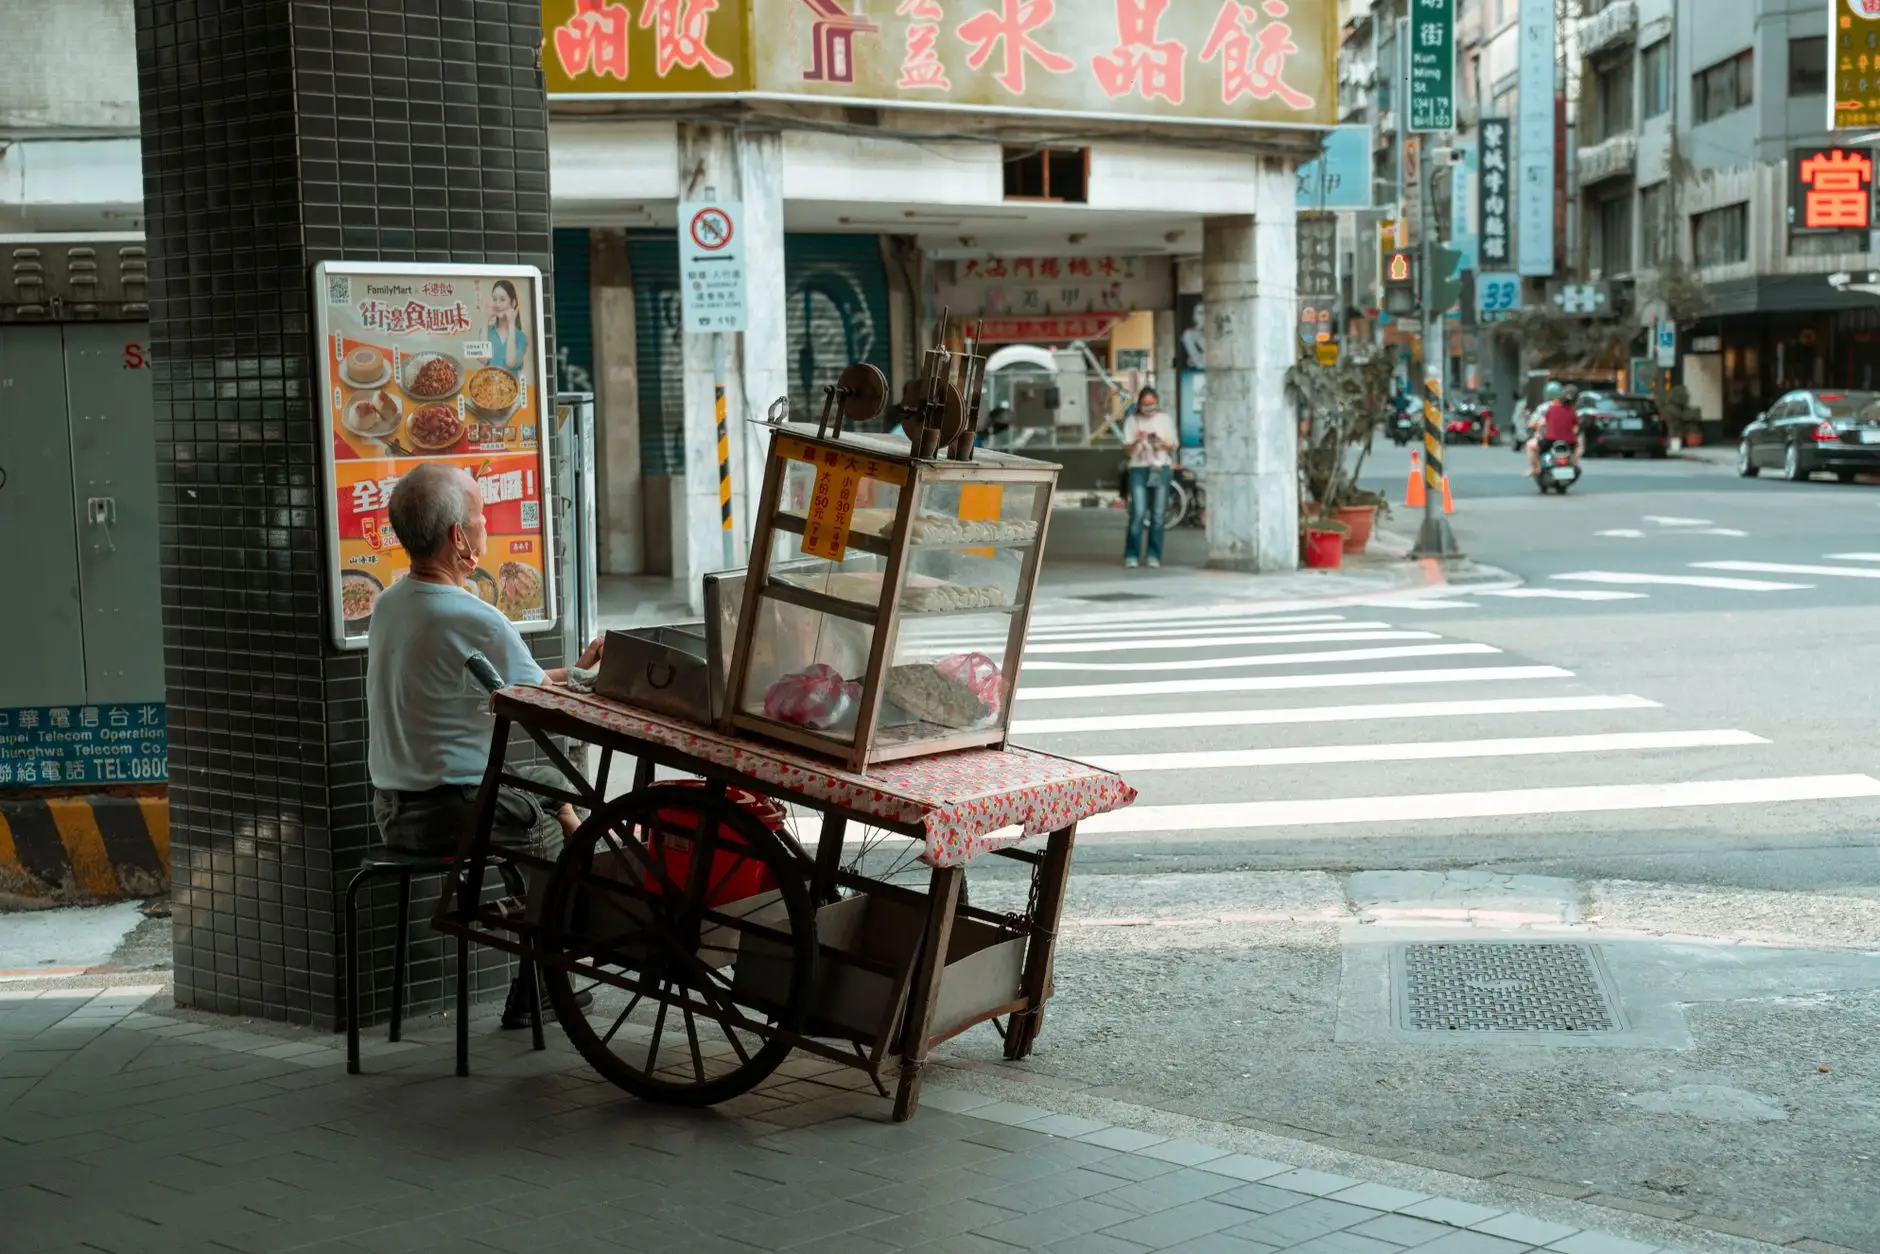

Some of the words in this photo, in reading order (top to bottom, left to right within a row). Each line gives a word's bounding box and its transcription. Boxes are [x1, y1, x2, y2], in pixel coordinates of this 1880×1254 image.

[1413, 53, 1437, 63] Kun
[1413, 68, 1441, 81] Ming
[1801, 150, 1872, 228] 當
[367, 284, 412, 296] FamilyMart
[1484, 282, 1516, 308] 33
[358, 300, 470, 333] 街邊食趣味
[37, 731, 93, 742] Telecom
[100, 728, 165, 743] Operation
[73, 744, 133, 756] Telecom
